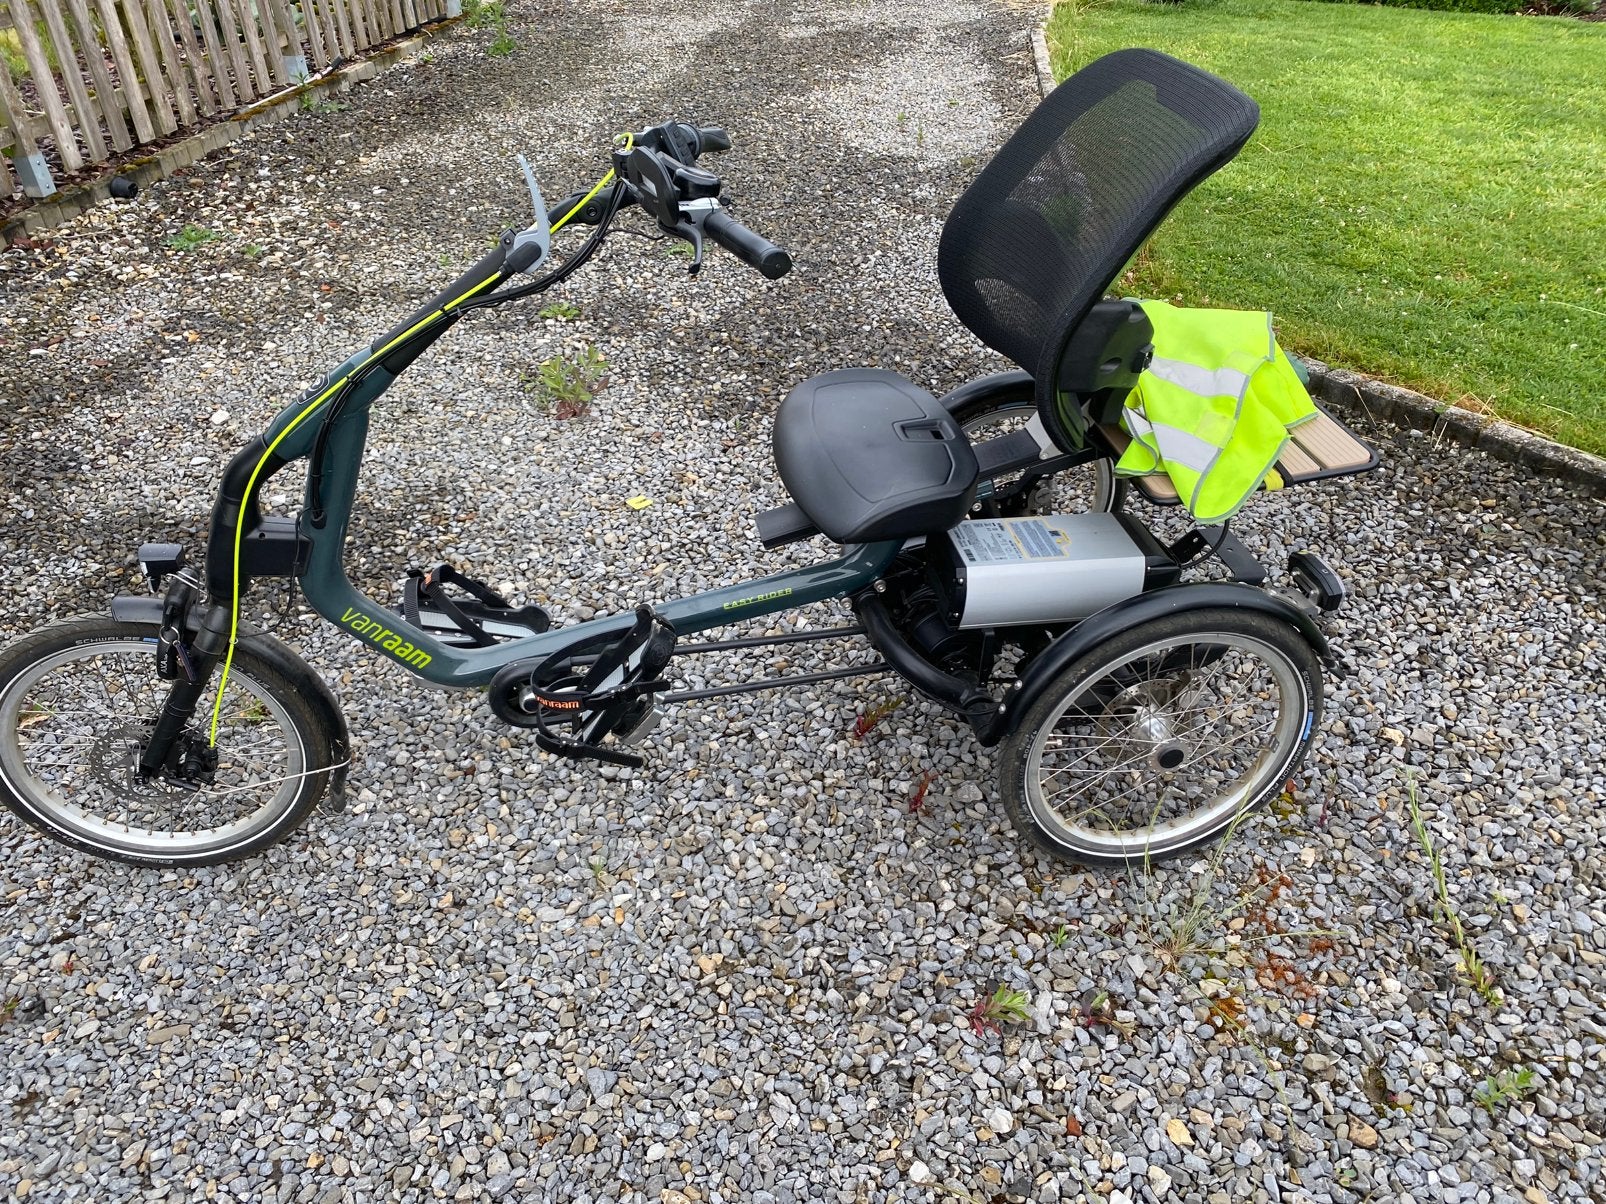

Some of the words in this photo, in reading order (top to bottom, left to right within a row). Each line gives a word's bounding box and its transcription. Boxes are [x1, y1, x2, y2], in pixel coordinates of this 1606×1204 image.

[723, 596, 753, 610] EASY
[757, 587, 792, 602] RIDER
[75, 636, 141, 646] SCHWALBE
[340, 606, 433, 669] vanraam
